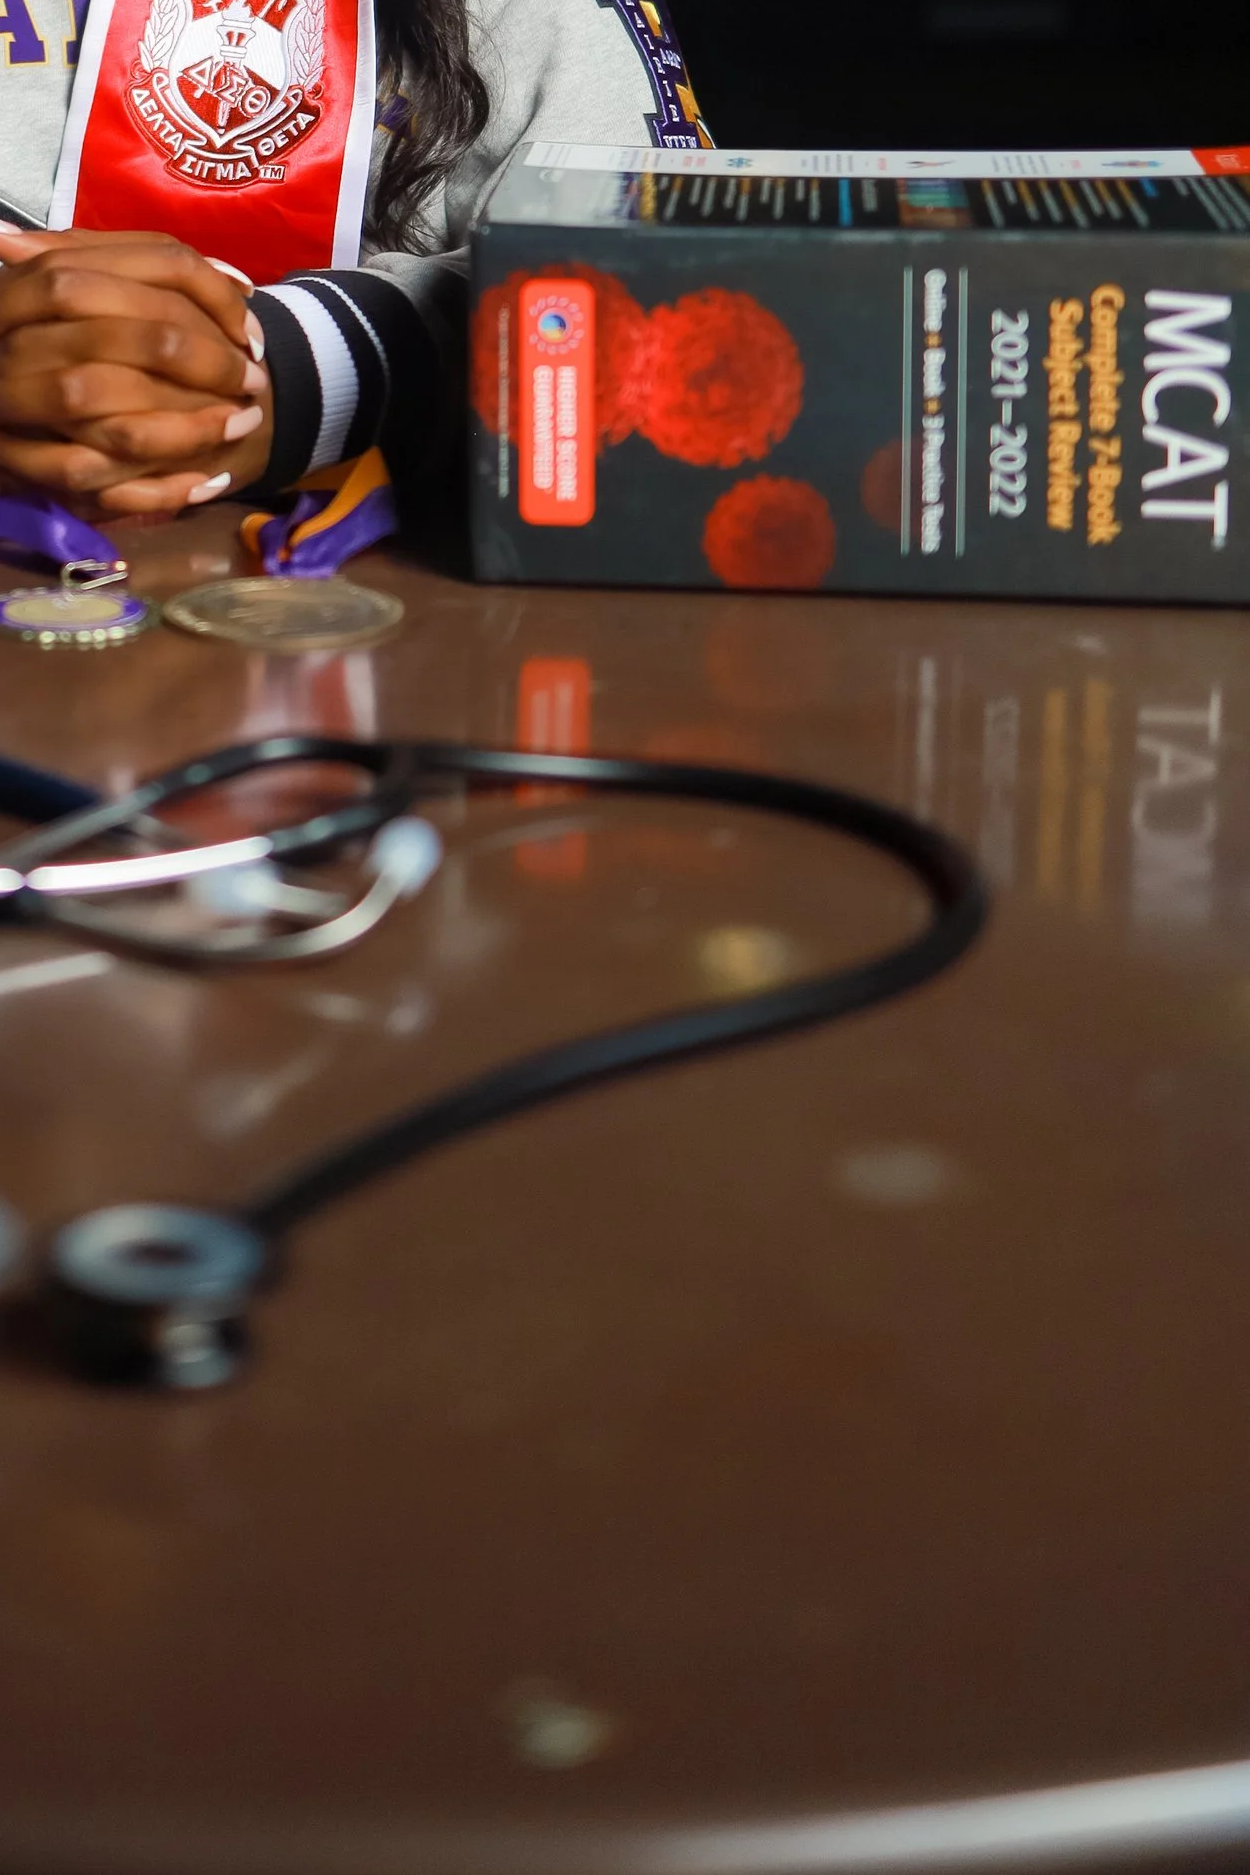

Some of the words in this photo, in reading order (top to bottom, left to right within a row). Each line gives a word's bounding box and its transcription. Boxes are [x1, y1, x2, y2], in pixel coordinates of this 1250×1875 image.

[923, 268, 947, 333] Online
[1043, 298, 1084, 417] Subject
[1084, 283, 1126, 432] Complete
[1141, 290, 1232, 538] MCAT
[1046, 421, 1082, 532] Review
[1086, 436, 1121, 545] 7-Book
